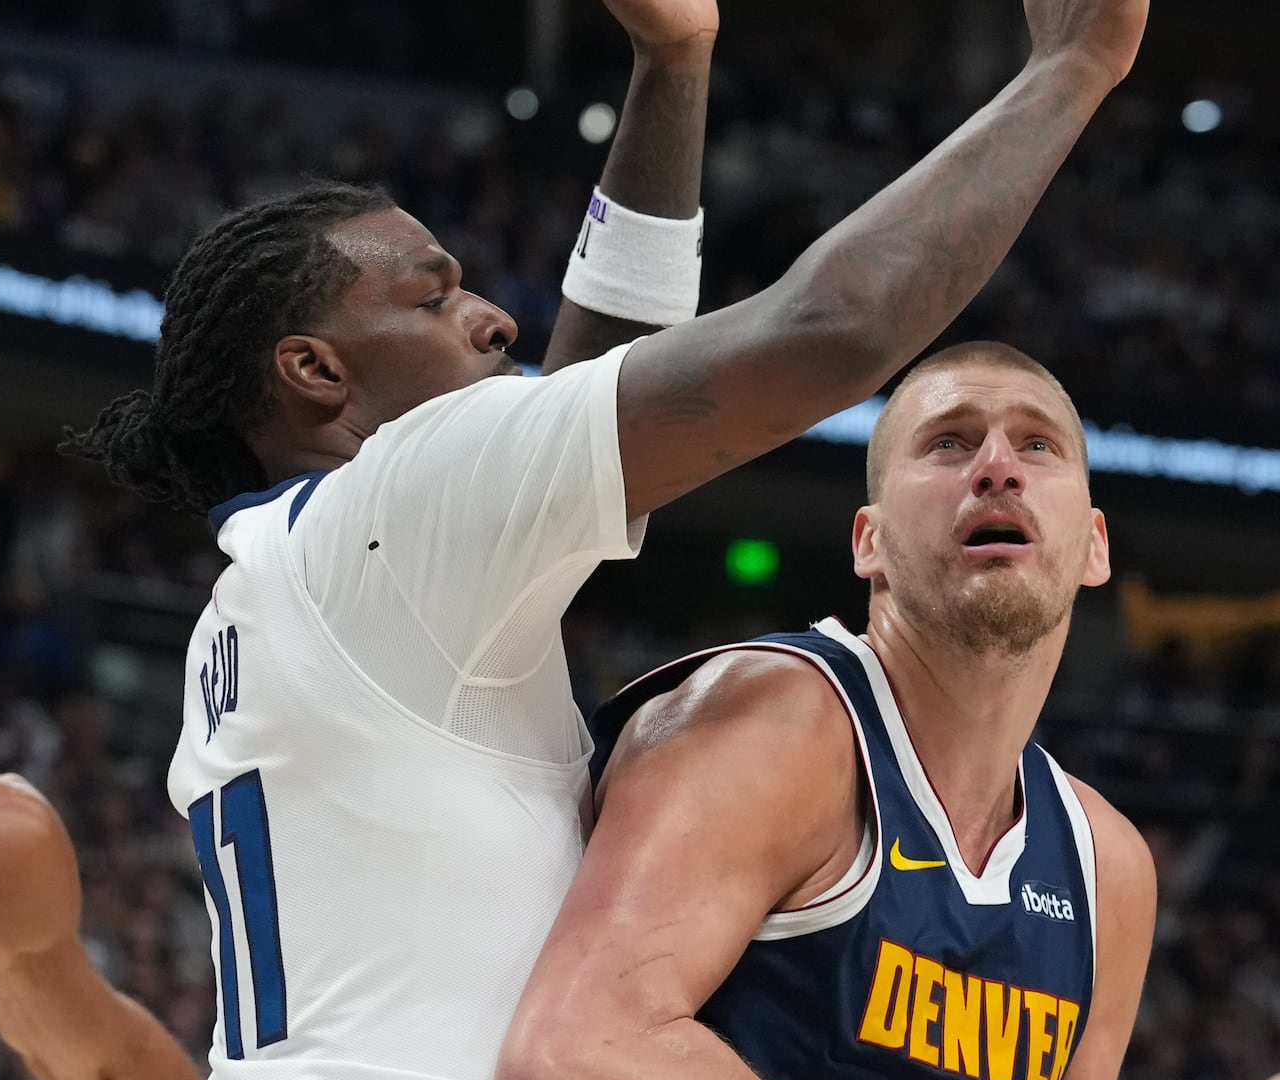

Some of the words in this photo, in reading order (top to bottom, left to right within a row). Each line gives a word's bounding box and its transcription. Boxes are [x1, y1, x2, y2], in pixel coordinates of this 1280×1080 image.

[200, 625, 238, 746] REID
[187, 768, 288, 1060] 11
[1022, 884, 1075, 921] ibotta
